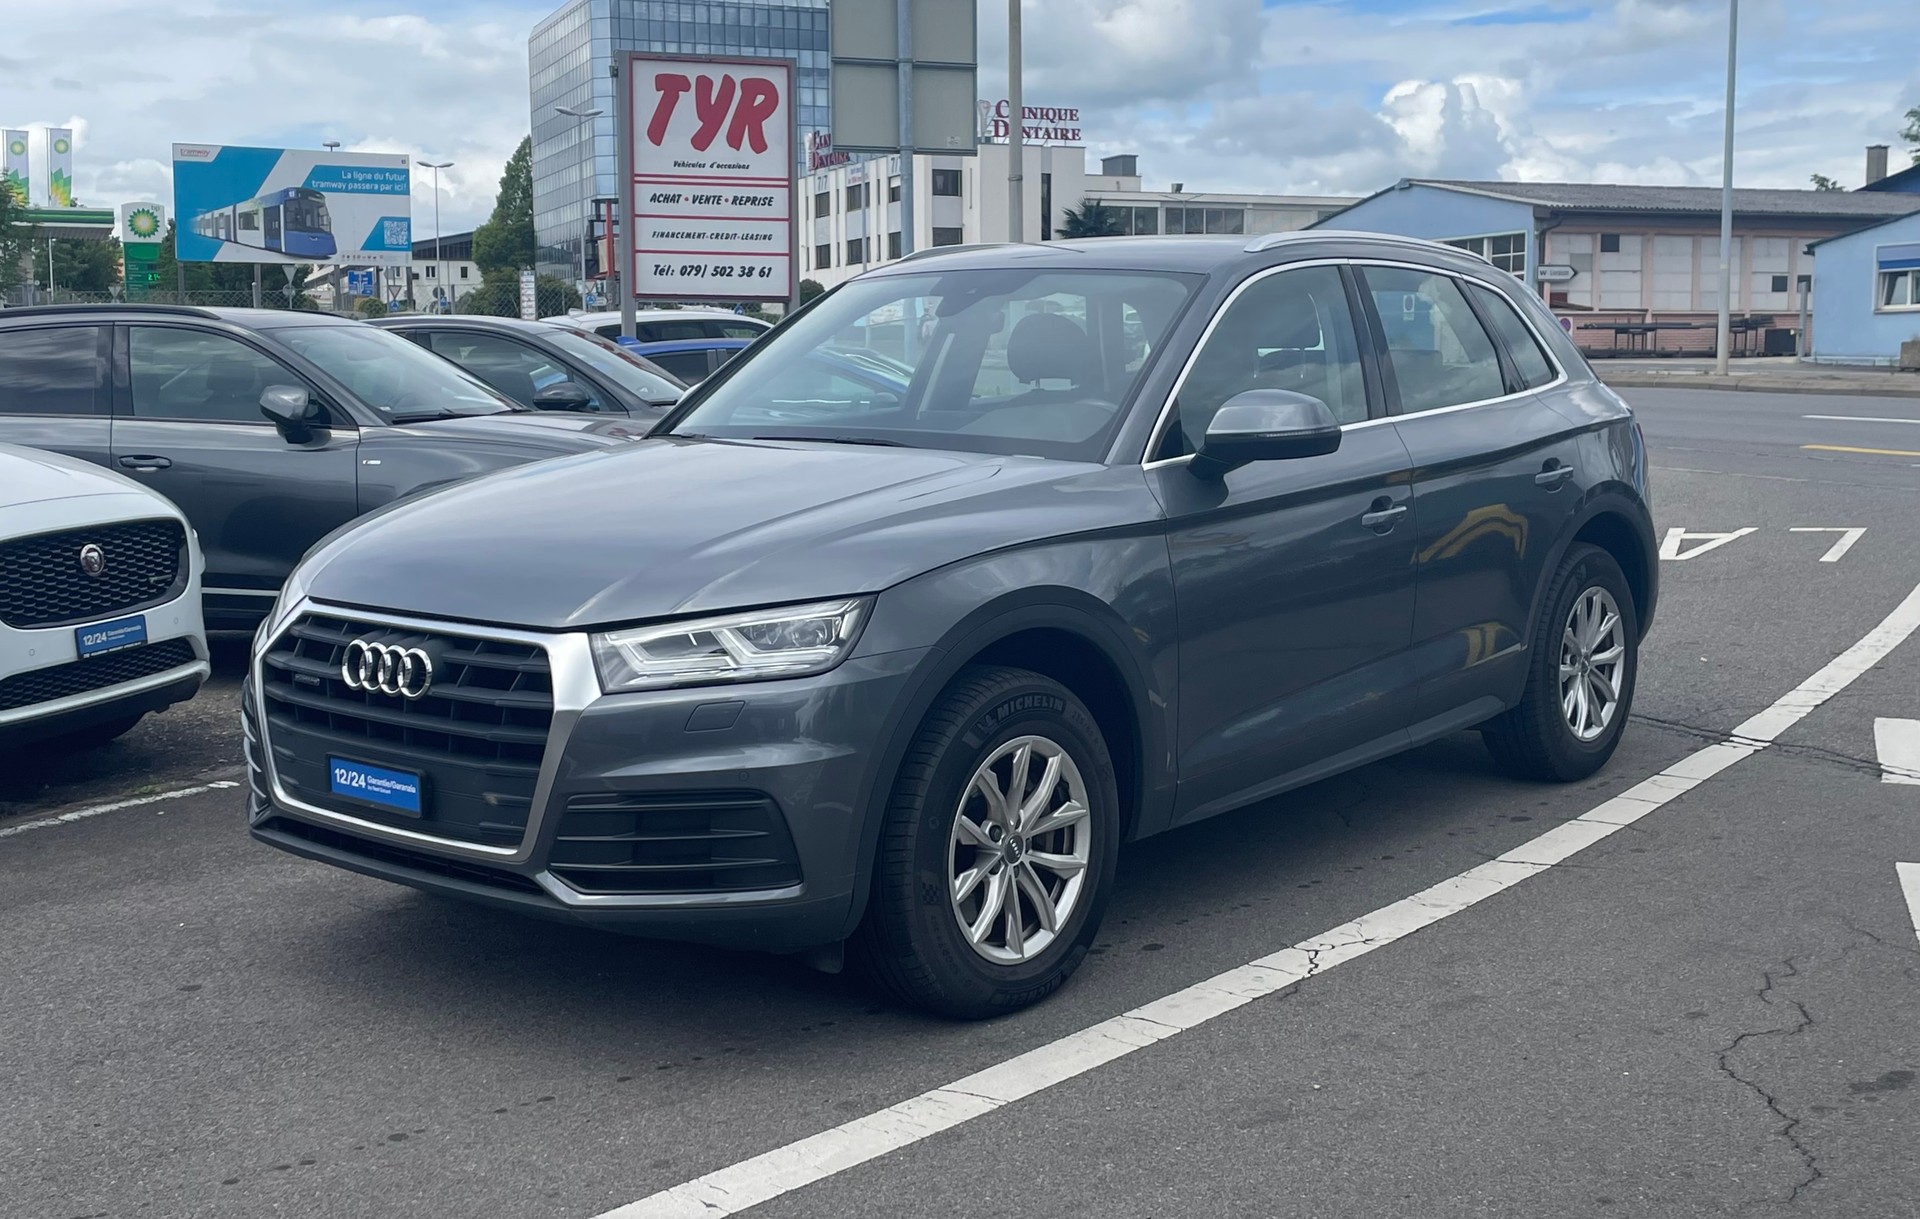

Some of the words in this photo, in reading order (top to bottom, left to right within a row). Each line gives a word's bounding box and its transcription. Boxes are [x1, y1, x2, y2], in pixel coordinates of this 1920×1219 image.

[646, 73, 780, 155] TYR
[995, 99, 1079, 123] CINIQUE
[992, 119, 1082, 141] DNTAIRE
[673, 160, 706, 169] Véhicules
[710, 161, 750, 170] d'occasions
[341, 170, 352, 179] La
[353, 171, 372, 181] ligne
[373, 172, 384, 180] du
[385, 172, 406, 180] futur
[312, 180, 346, 190] tramway
[650, 193, 682, 204] ACHAT
[692, 194, 723, 205] VENTE
[731, 195, 774, 207] REPRISE
[741, 233, 773, 241] LEASING
[653, 264, 675, 276] Tél:
[711, 265, 734, 278] 502
[737, 266, 755, 278] 38
[758, 266, 772, 278] 61
[83, 631, 107, 646] 12/24
[997, 695, 1064, 721] MICHELIN
[334, 768, 366, 789] 12/24
